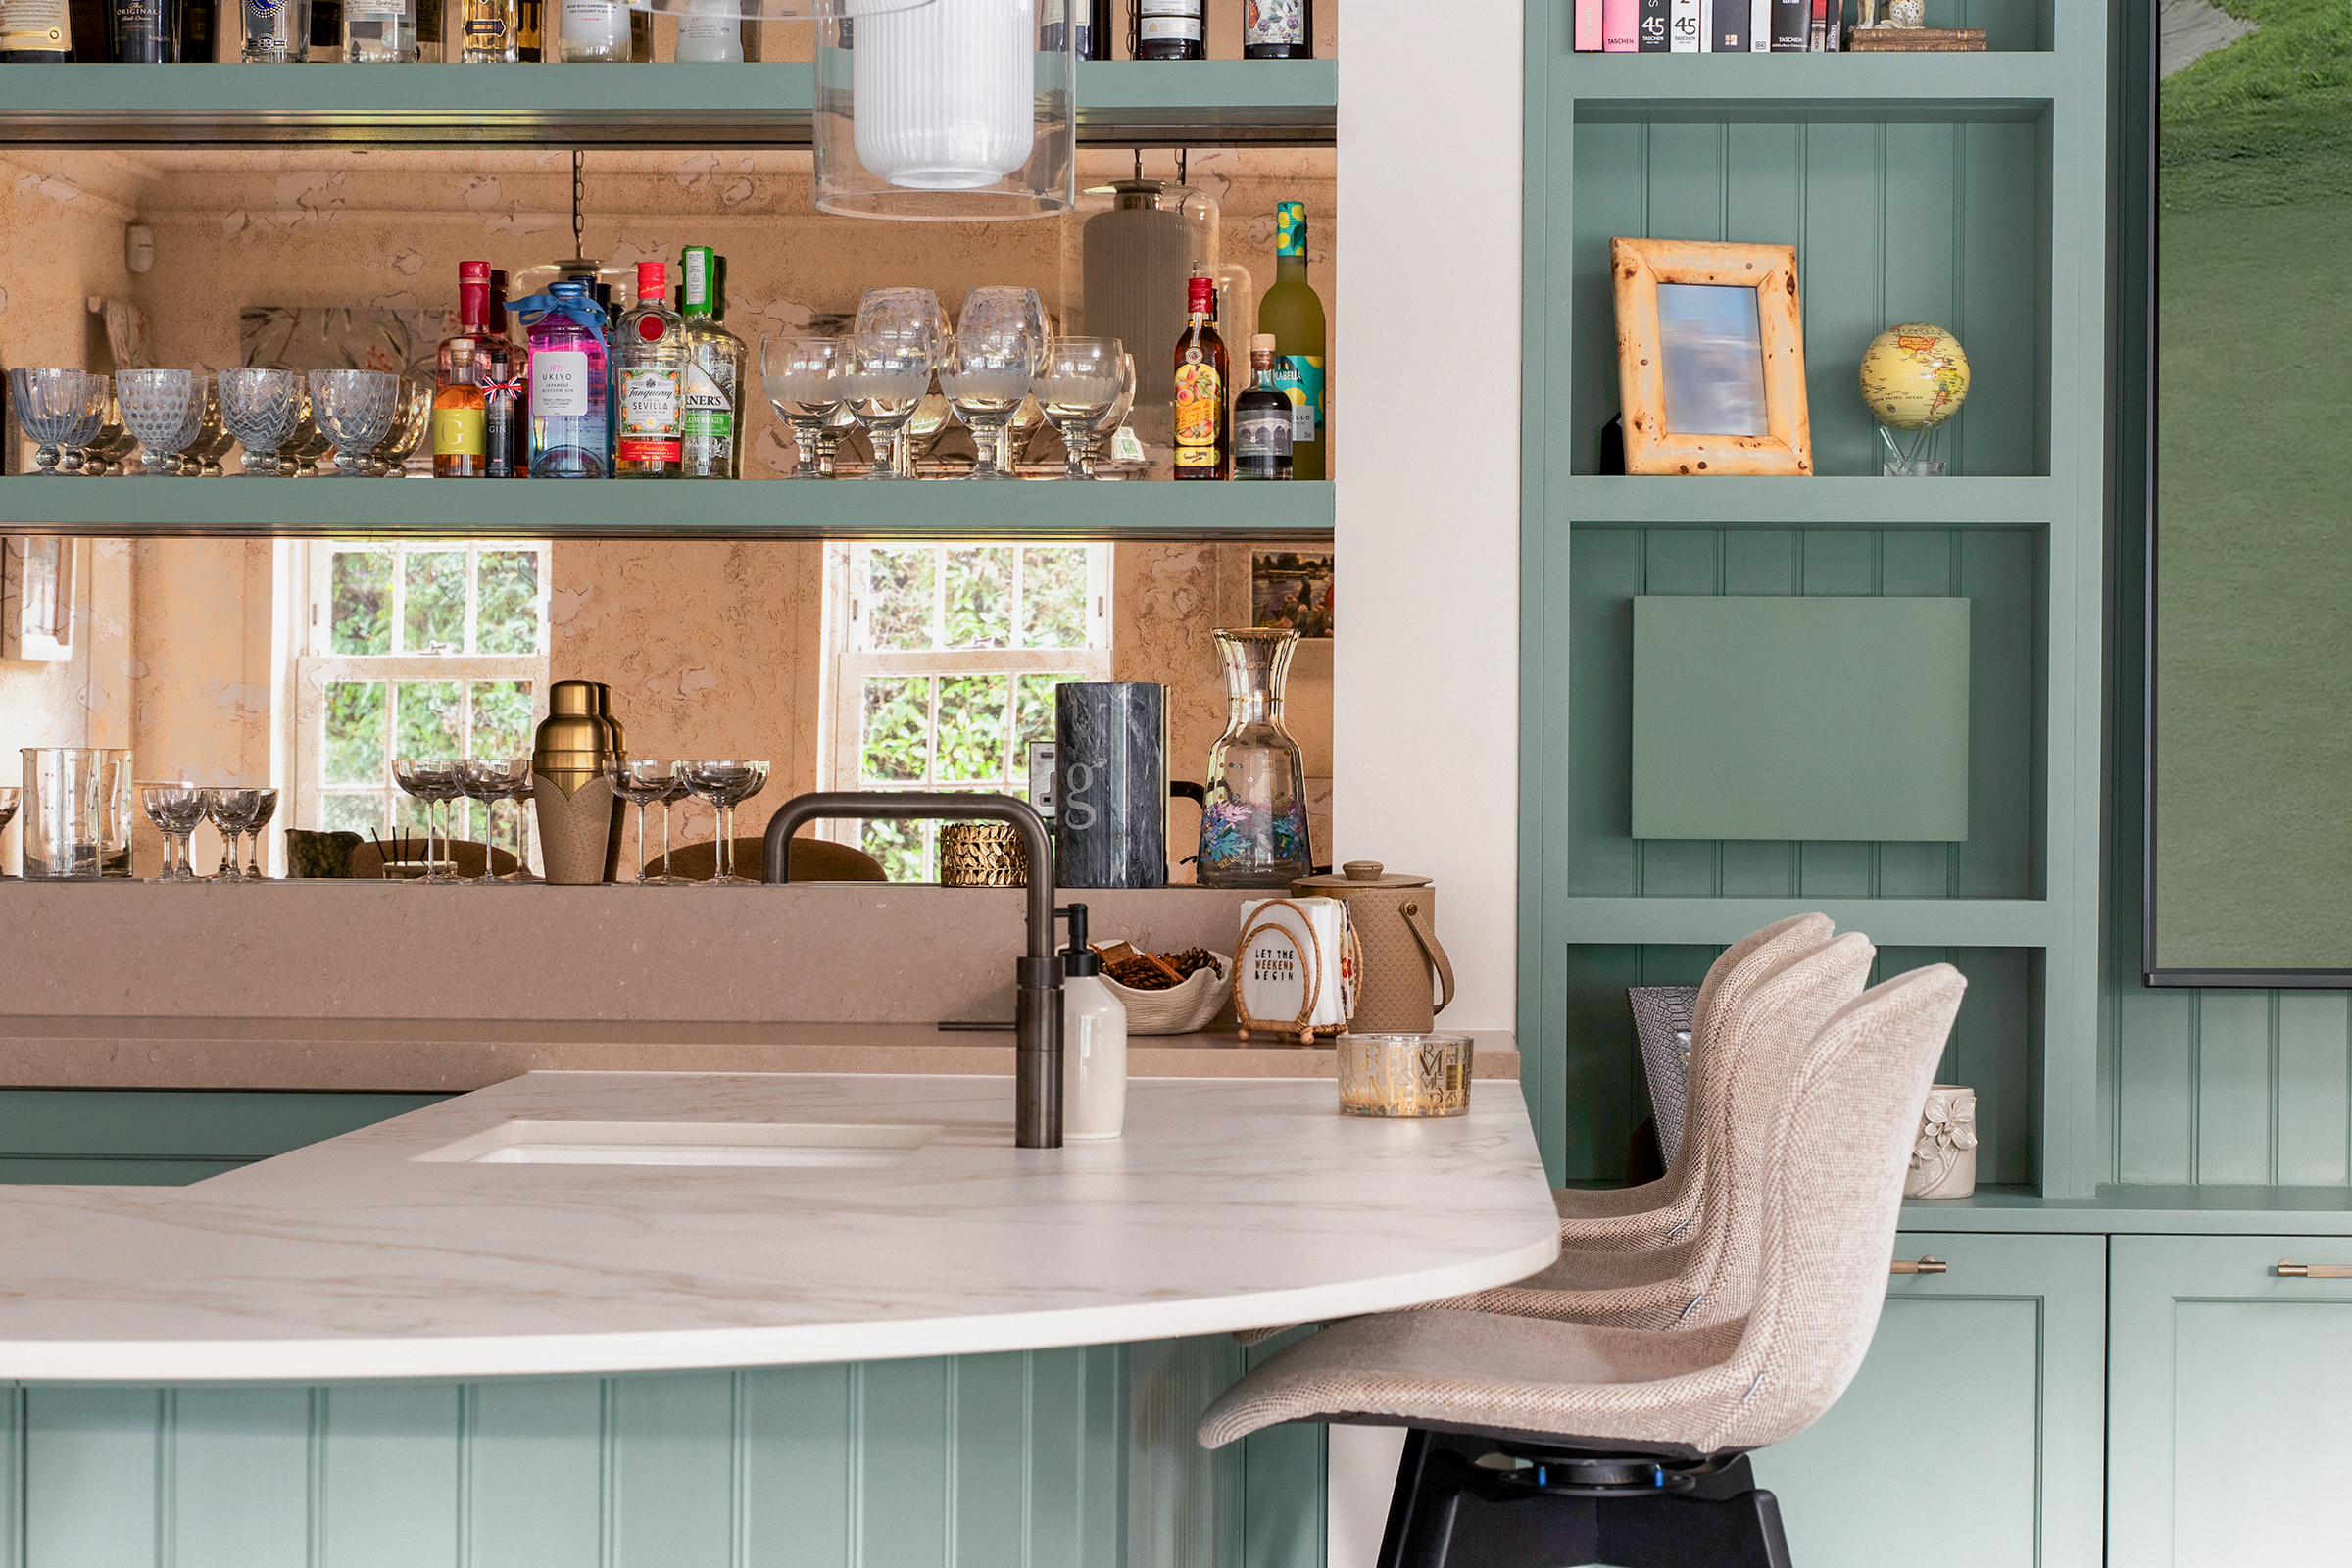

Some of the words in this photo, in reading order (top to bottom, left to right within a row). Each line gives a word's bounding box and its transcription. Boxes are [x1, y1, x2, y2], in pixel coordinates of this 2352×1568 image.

[1642, 15, 1665, 36] 45
[1674, 16, 1696, 36] 45
[628, 386, 673, 400] Tanqueray
[632, 402, 668, 411] SEVILLA
[441, 419, 465, 446] G
[488, 425, 507, 434] GIN
[1065, 757, 1108, 831] g
[1255, 949, 1272, 959] LET
[1277, 950, 1294, 960] THE
[1255, 960, 1294, 971] WEEKEND
[1255, 970, 1294, 981] BEGIN
